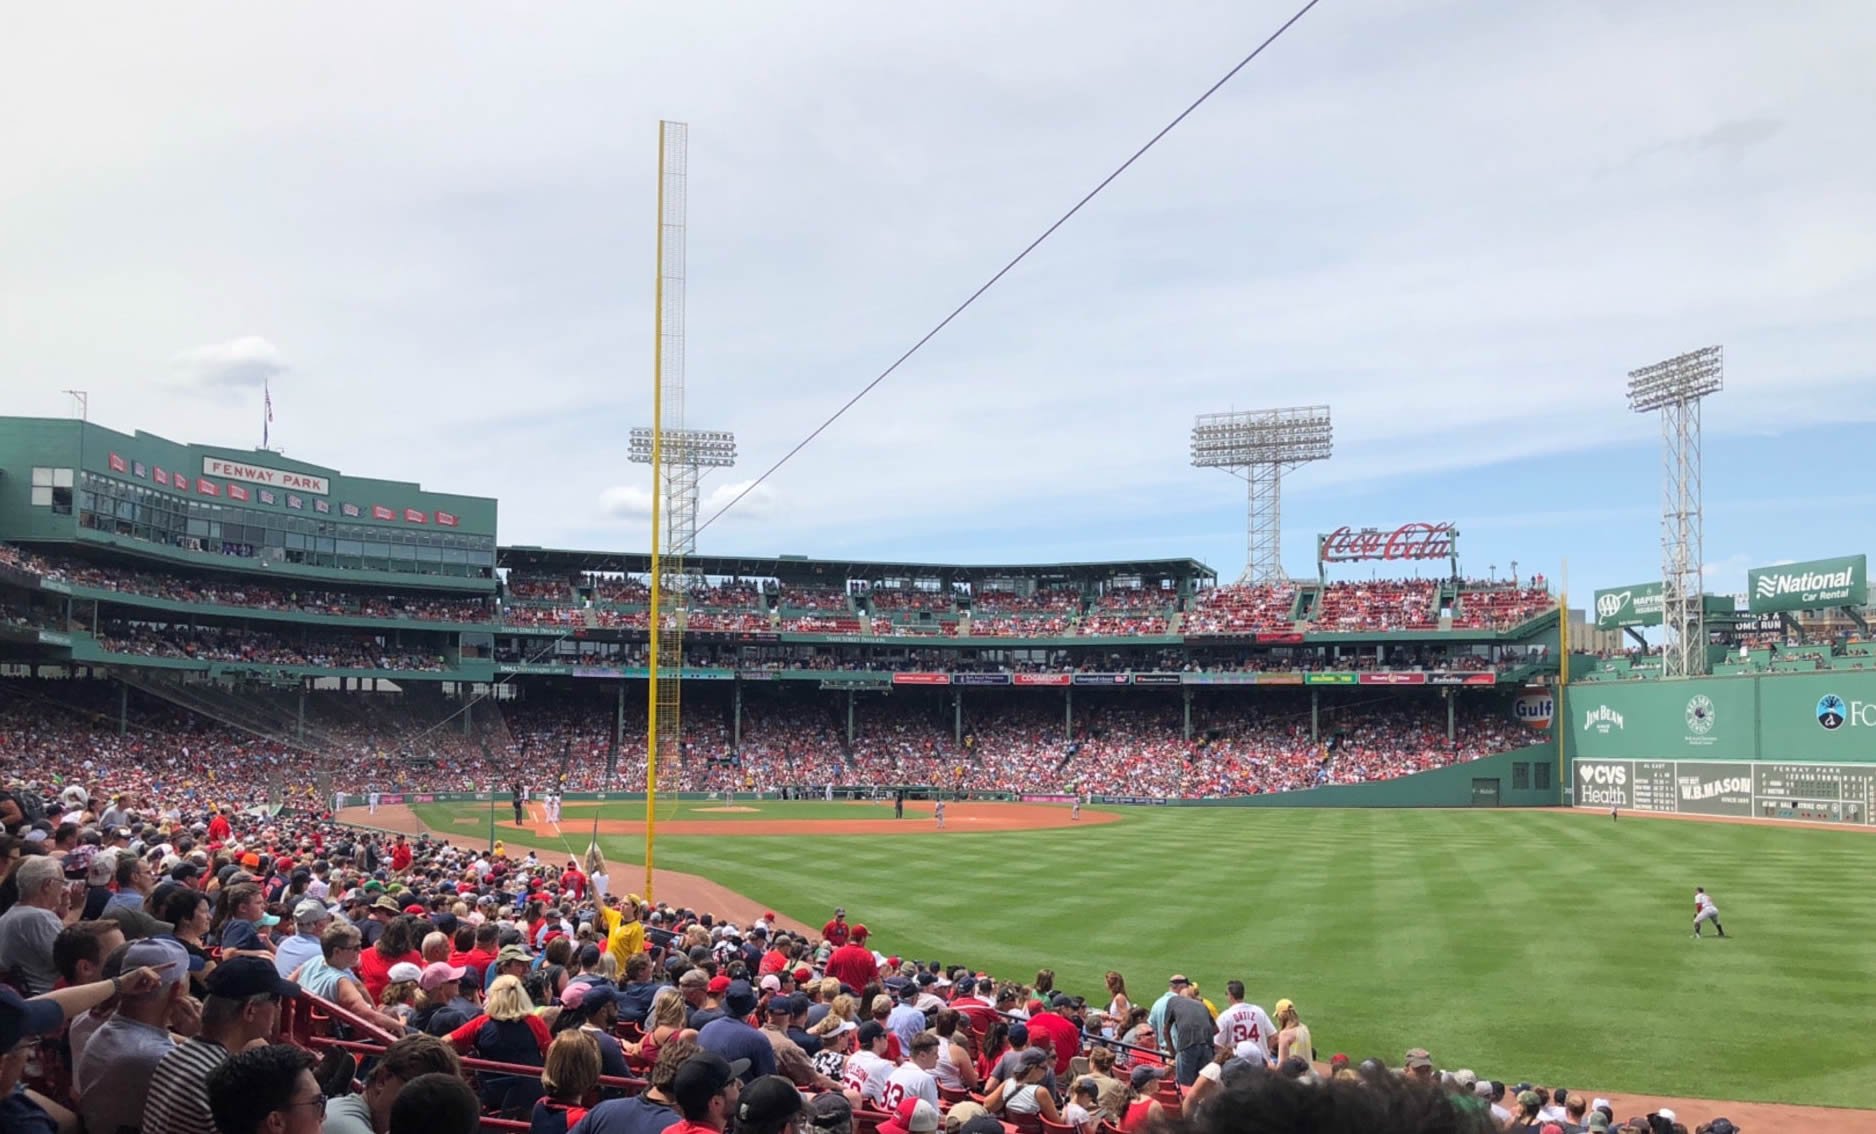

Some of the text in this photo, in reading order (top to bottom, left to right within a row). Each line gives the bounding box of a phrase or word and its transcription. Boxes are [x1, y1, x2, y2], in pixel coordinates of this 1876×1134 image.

[212, 462, 322, 490] FENWAY PARK
[1776, 566, 1853, 594] National
[1802, 588, 1849, 602] Car Rental
[1761, 620, 1781, 630] RUN
[1515, 700, 1552, 717] Gulf
[1584, 704, 1624, 731] JIM BEAM
[1594, 765, 1626, 785] CVS
[1582, 785, 1627, 805] Health
[1233, 1011, 1256, 1022] ORTIZ
[1233, 1023, 1260, 1043] 34
